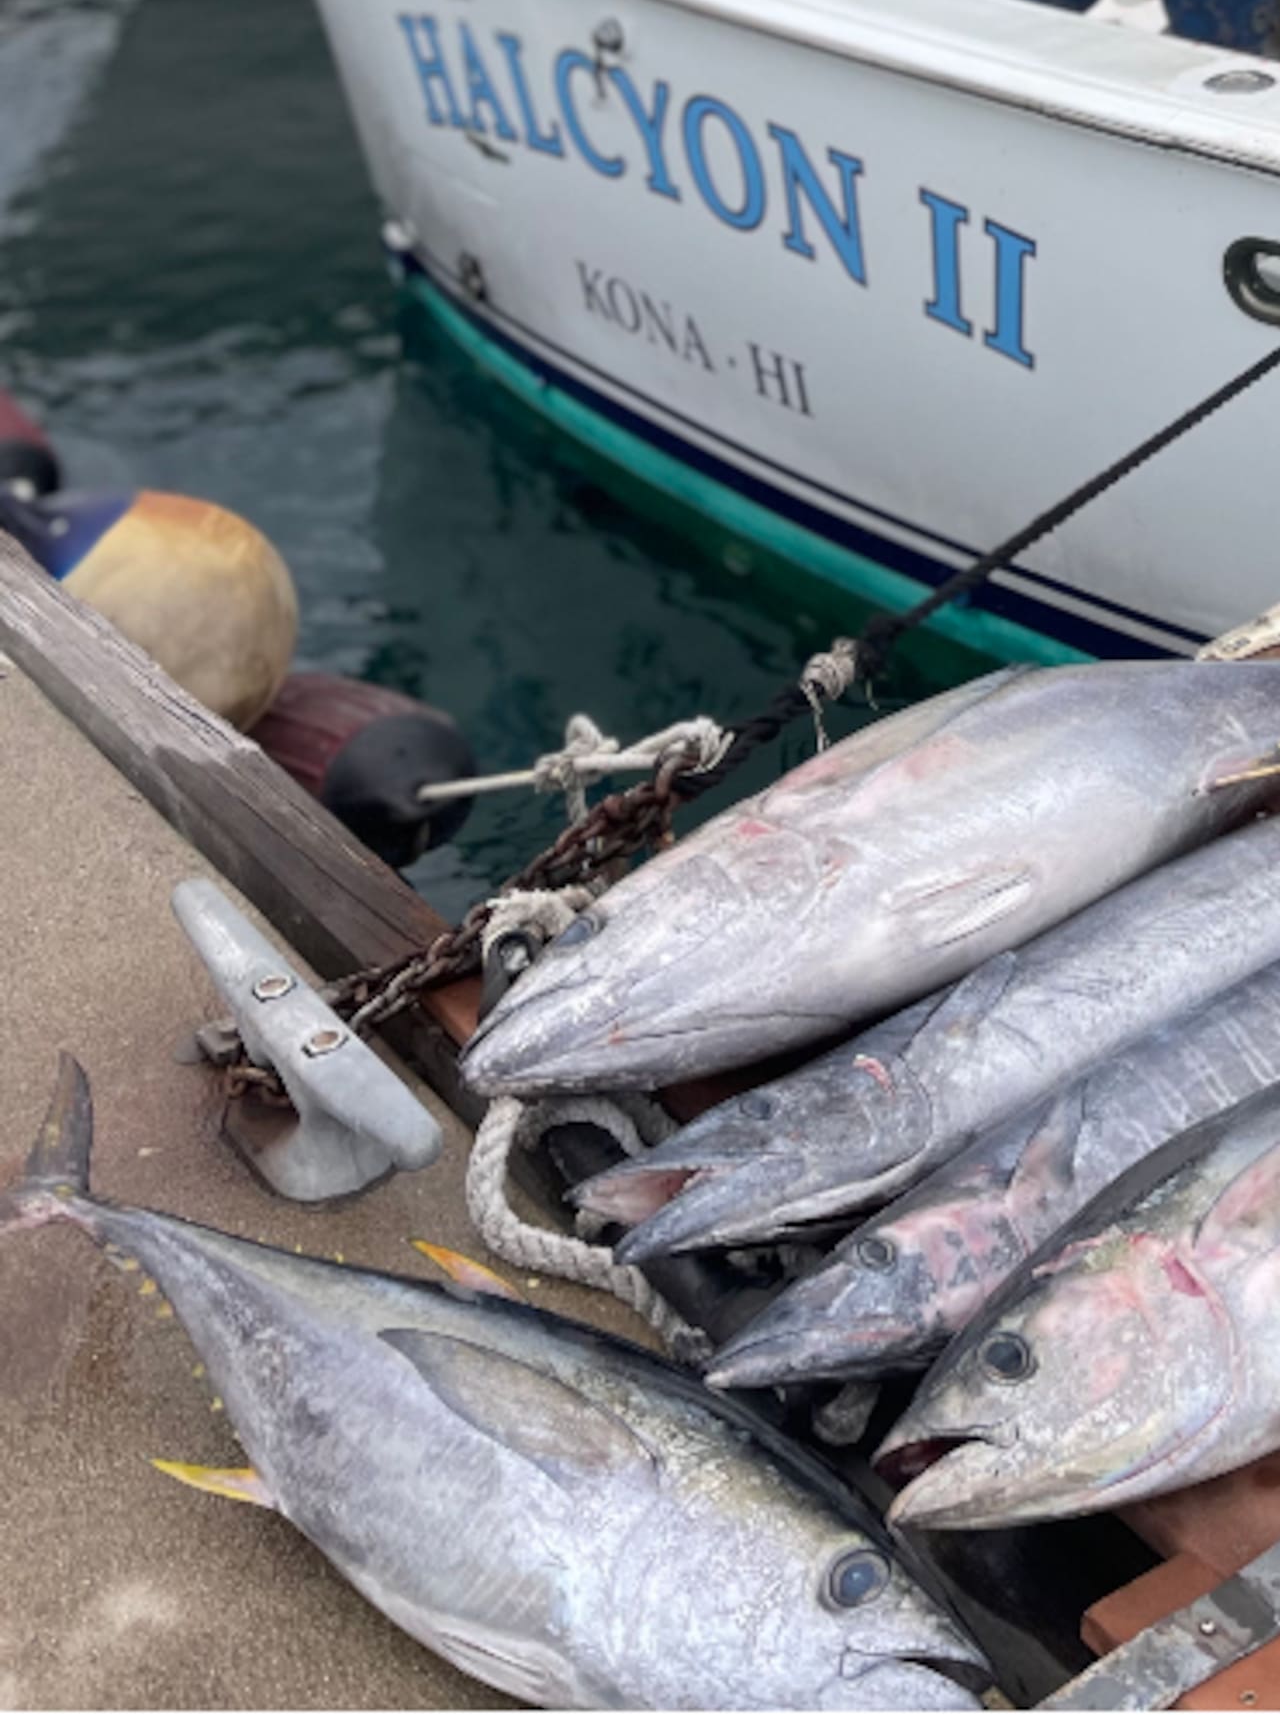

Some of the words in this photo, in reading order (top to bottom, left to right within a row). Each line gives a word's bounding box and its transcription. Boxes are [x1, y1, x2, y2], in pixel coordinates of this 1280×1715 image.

[397, 13, 867, 288] HALCYON
[918, 186, 1036, 371] II
[575, 259, 716, 373] KONA
[746, 340, 815, 418] HI
